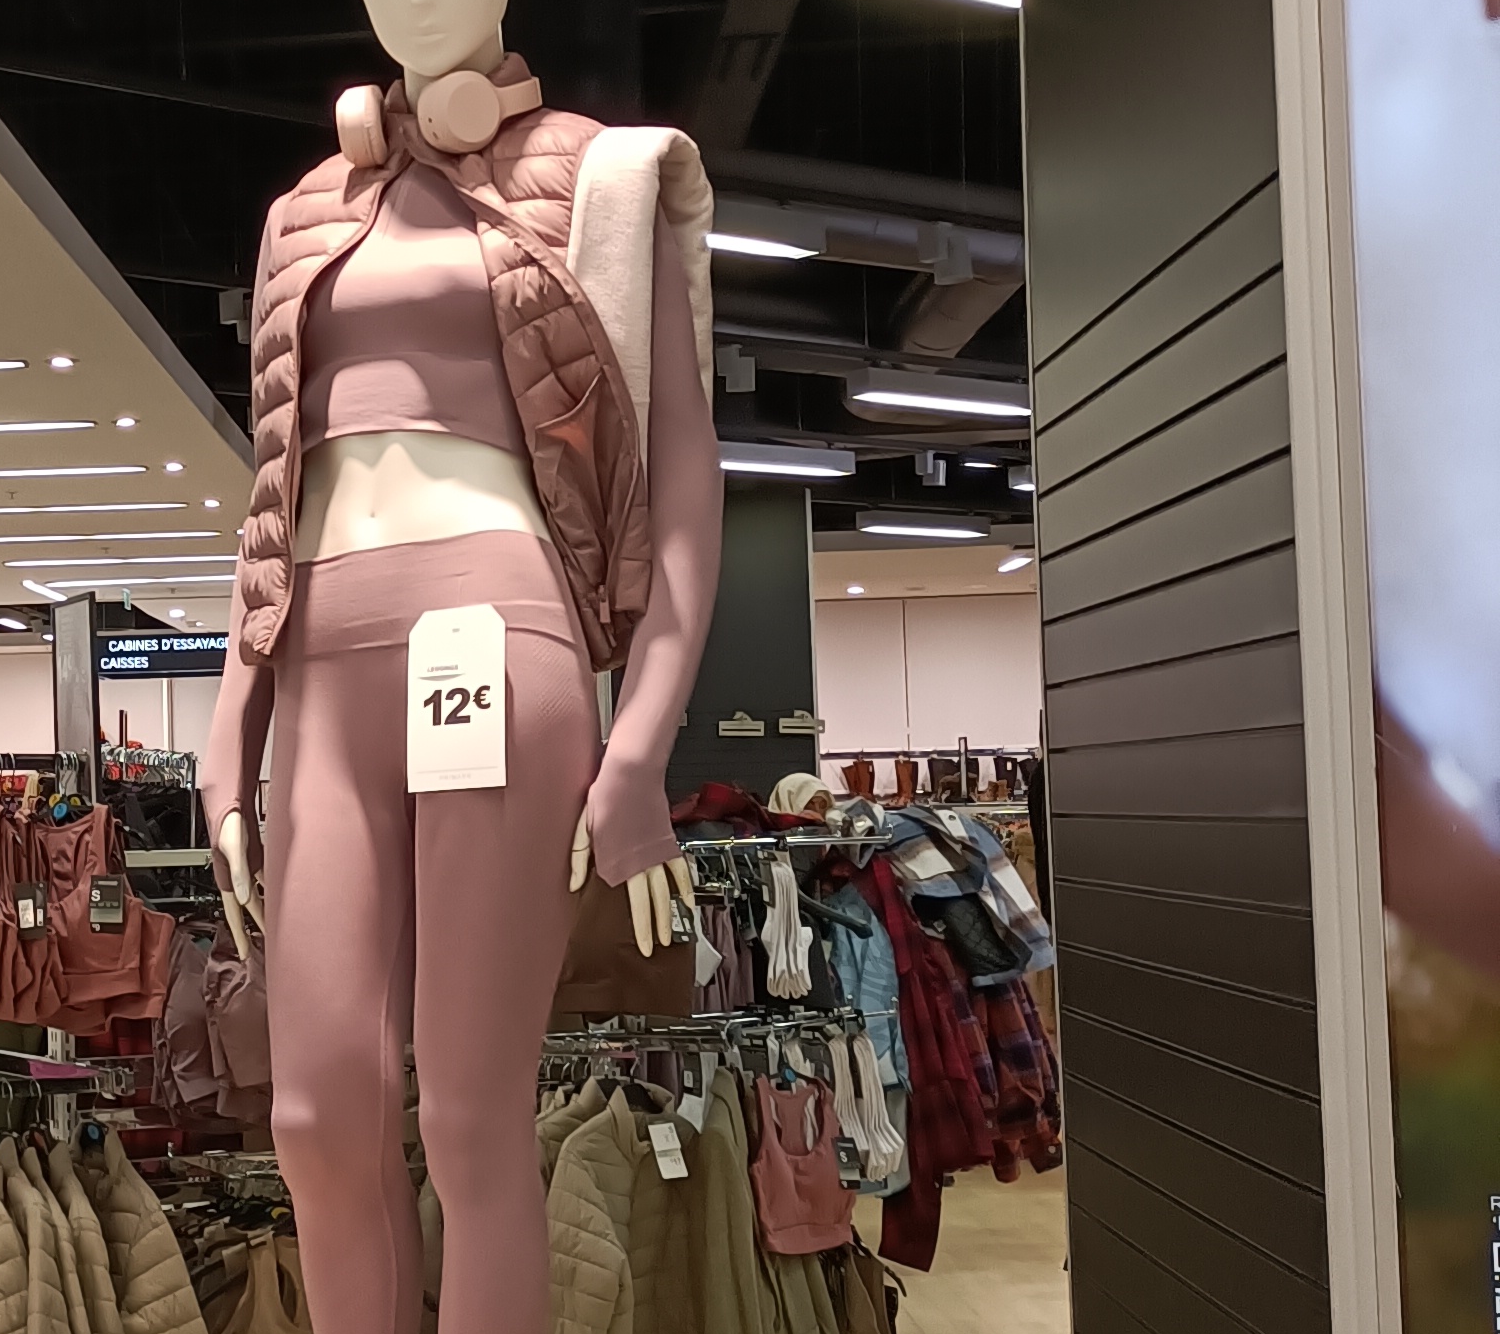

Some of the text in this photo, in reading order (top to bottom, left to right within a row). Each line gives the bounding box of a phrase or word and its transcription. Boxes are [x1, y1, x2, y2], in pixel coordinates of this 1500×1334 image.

[108, 639, 158, 652] CABINES
[100, 657, 148, 669] CAISSES
[423, 685, 491, 726] 12€
[91, 889, 101, 902] S
[839, 1151, 848, 1163] S
